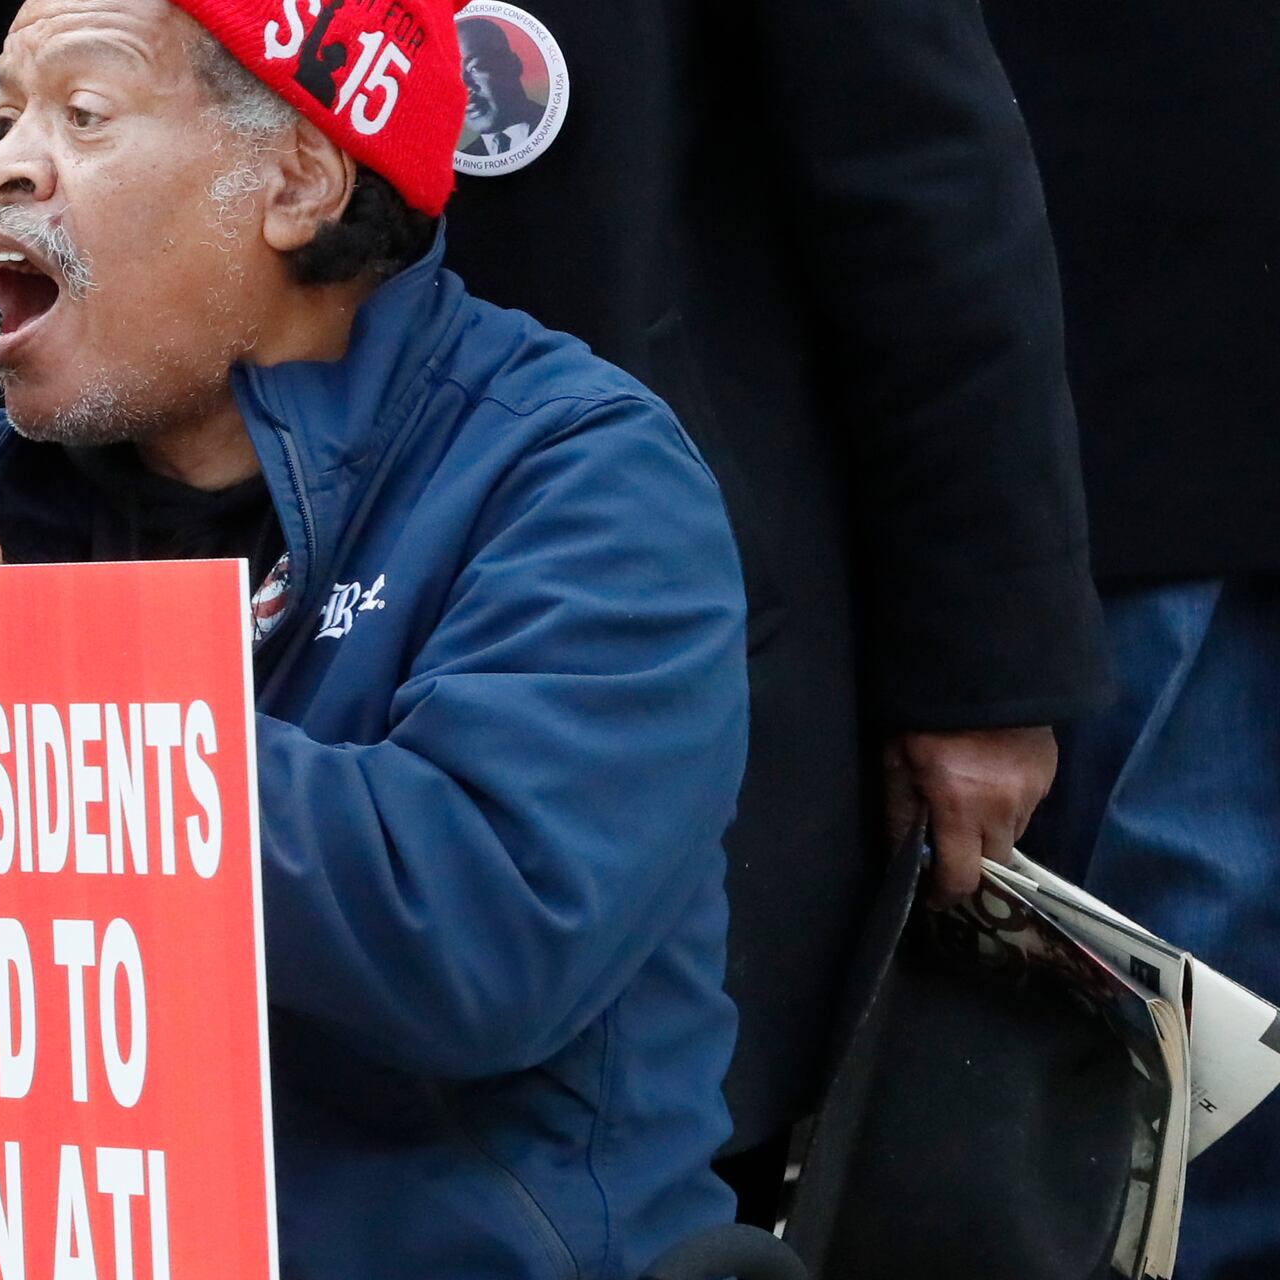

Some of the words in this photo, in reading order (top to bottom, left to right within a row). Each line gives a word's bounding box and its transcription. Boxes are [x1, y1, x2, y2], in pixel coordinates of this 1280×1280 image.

[382, 0, 426, 58] FOR
[503, 8, 548, 42] CONFERENCE
[555, 72, 564, 88] USA
[554, 89, 562, 104] GA
[532, 106, 559, 147] MOUNTAIN
[484, 157, 508, 169] FROM
[509, 144, 536, 164] STONE
[463, 160, 483, 170] RING
[52, 917, 147, 1109] TO
